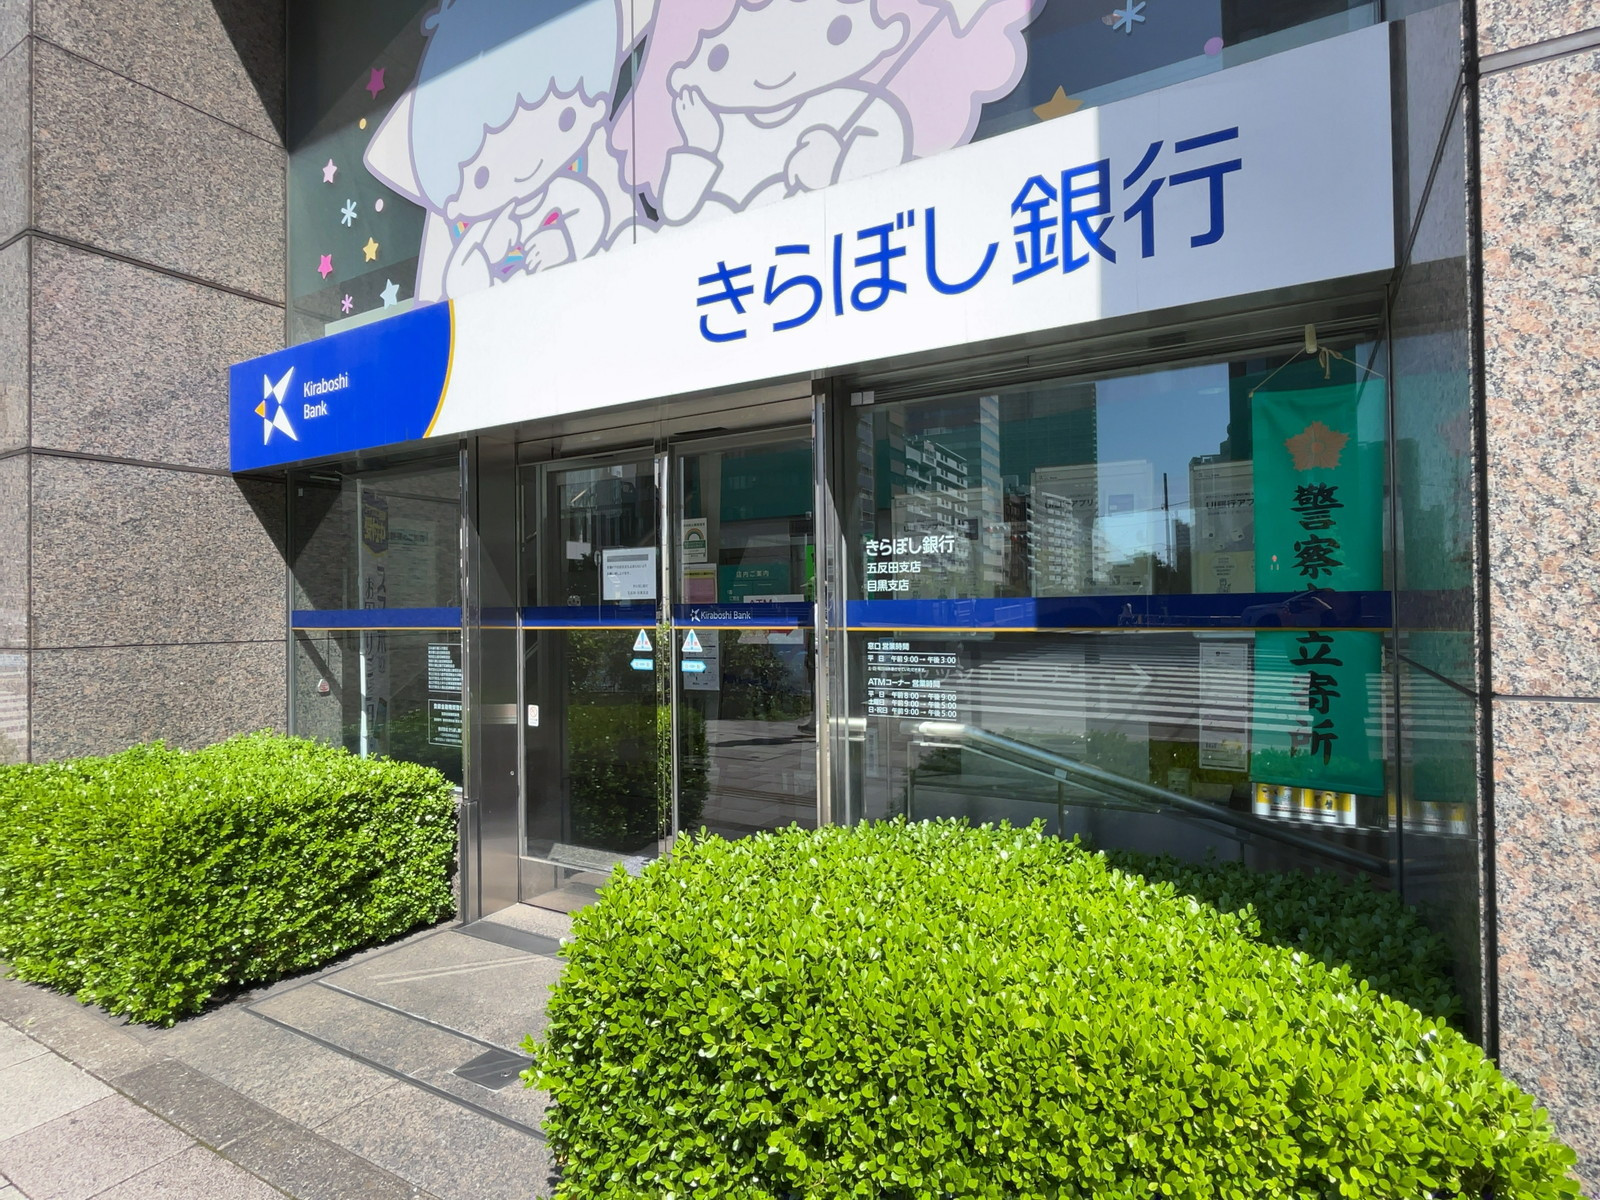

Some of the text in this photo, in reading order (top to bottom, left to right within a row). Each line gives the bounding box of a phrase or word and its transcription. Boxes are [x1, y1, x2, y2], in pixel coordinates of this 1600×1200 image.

[695, 125, 1243, 344] きらぼし銀行
[303, 371, 349, 397] Kiraboshi
[303, 400, 328, 419] Bank
[865, 534, 955, 557] きらぼし銀行
[866, 561, 922, 574] 五反田支店
[867, 579, 910, 592] 目黒支店
[700, 610, 751, 620] Kiraboshi Bank
[1289, 483, 1345, 766] 警察立寄所
[867, 642, 910, 651] 窓口 営業時間
[867, 677, 941, 688] ATMコーナー 営業時間
